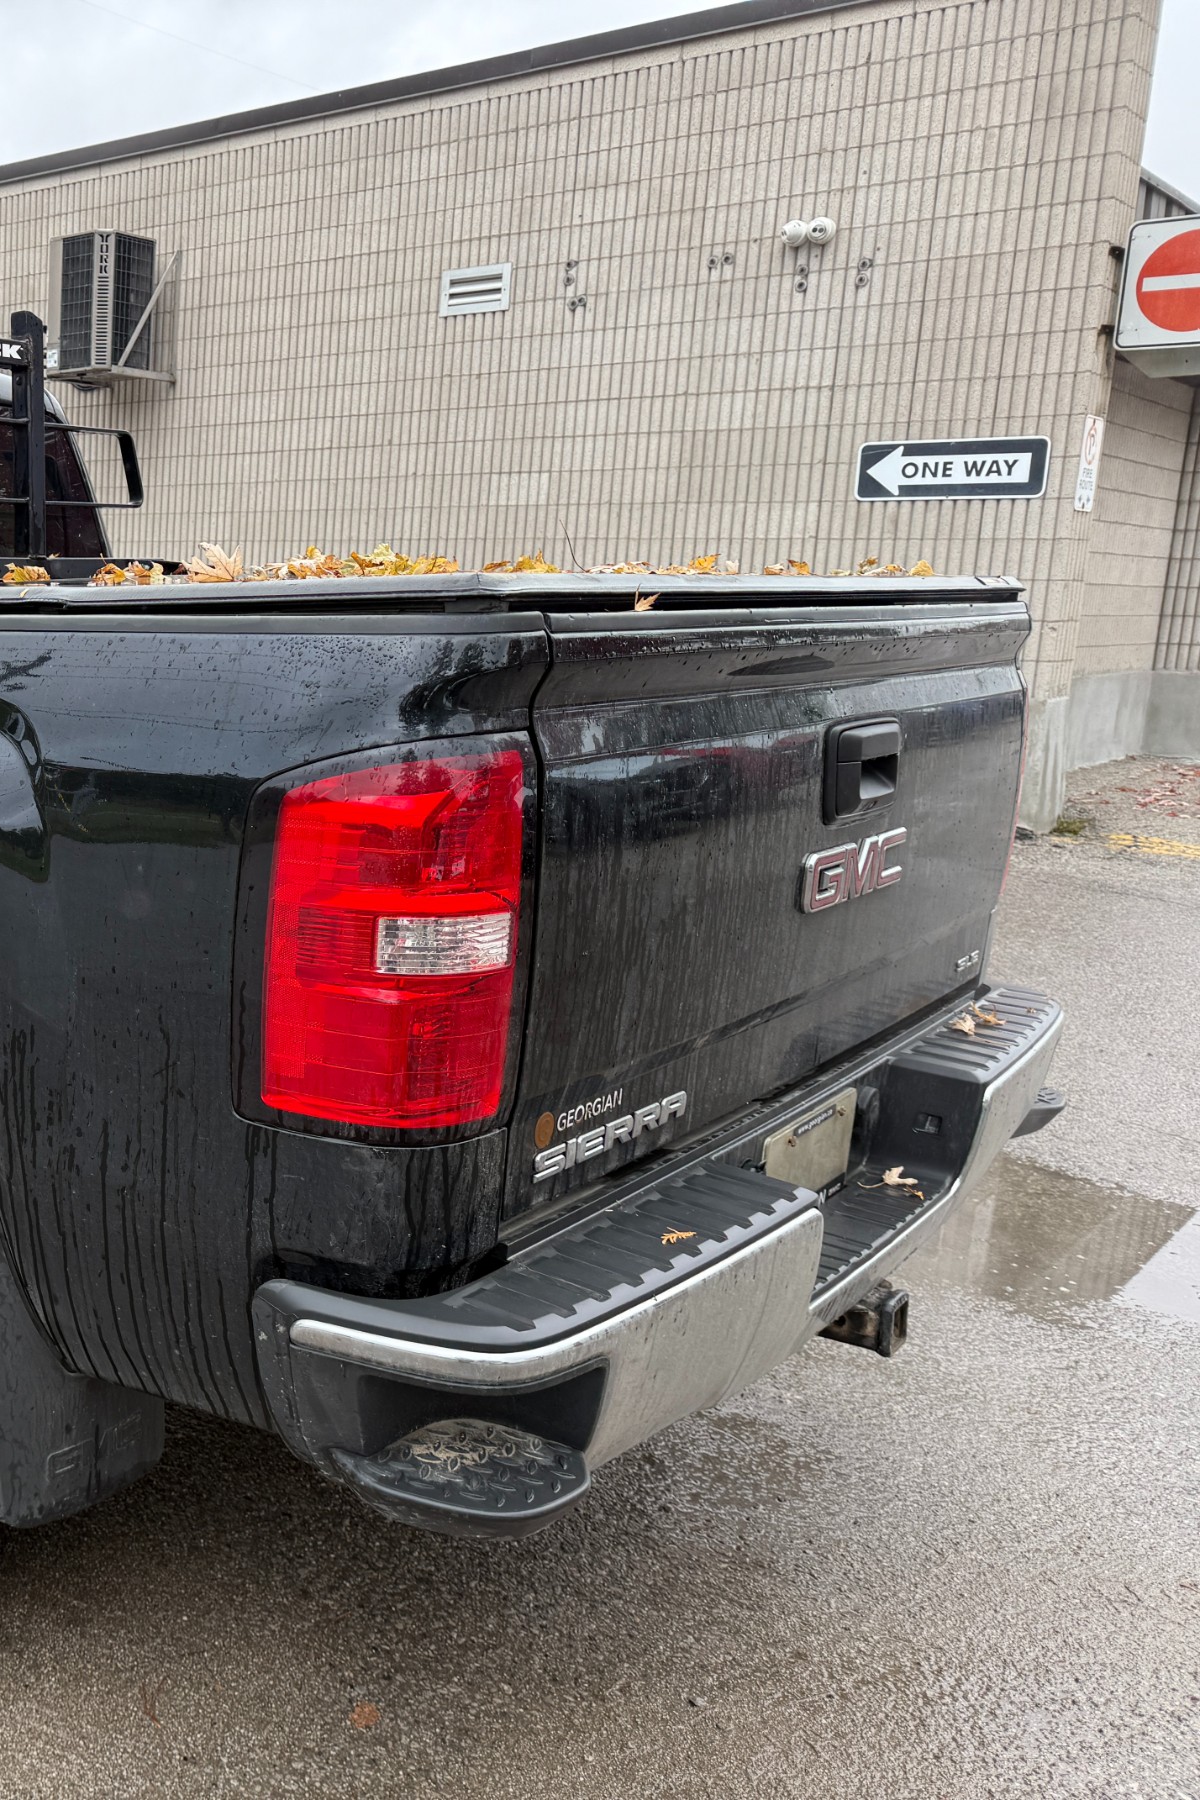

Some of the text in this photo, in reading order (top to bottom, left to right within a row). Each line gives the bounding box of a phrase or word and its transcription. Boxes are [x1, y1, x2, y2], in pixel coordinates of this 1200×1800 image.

[98, 234, 111, 274] YORK
[901, 459, 1019, 479] ONE WAY
[803, 827, 907, 914] GMC
[557, 1088, 623, 1131] GEORGIAN
[533, 1091, 688, 1184] SIERRA
